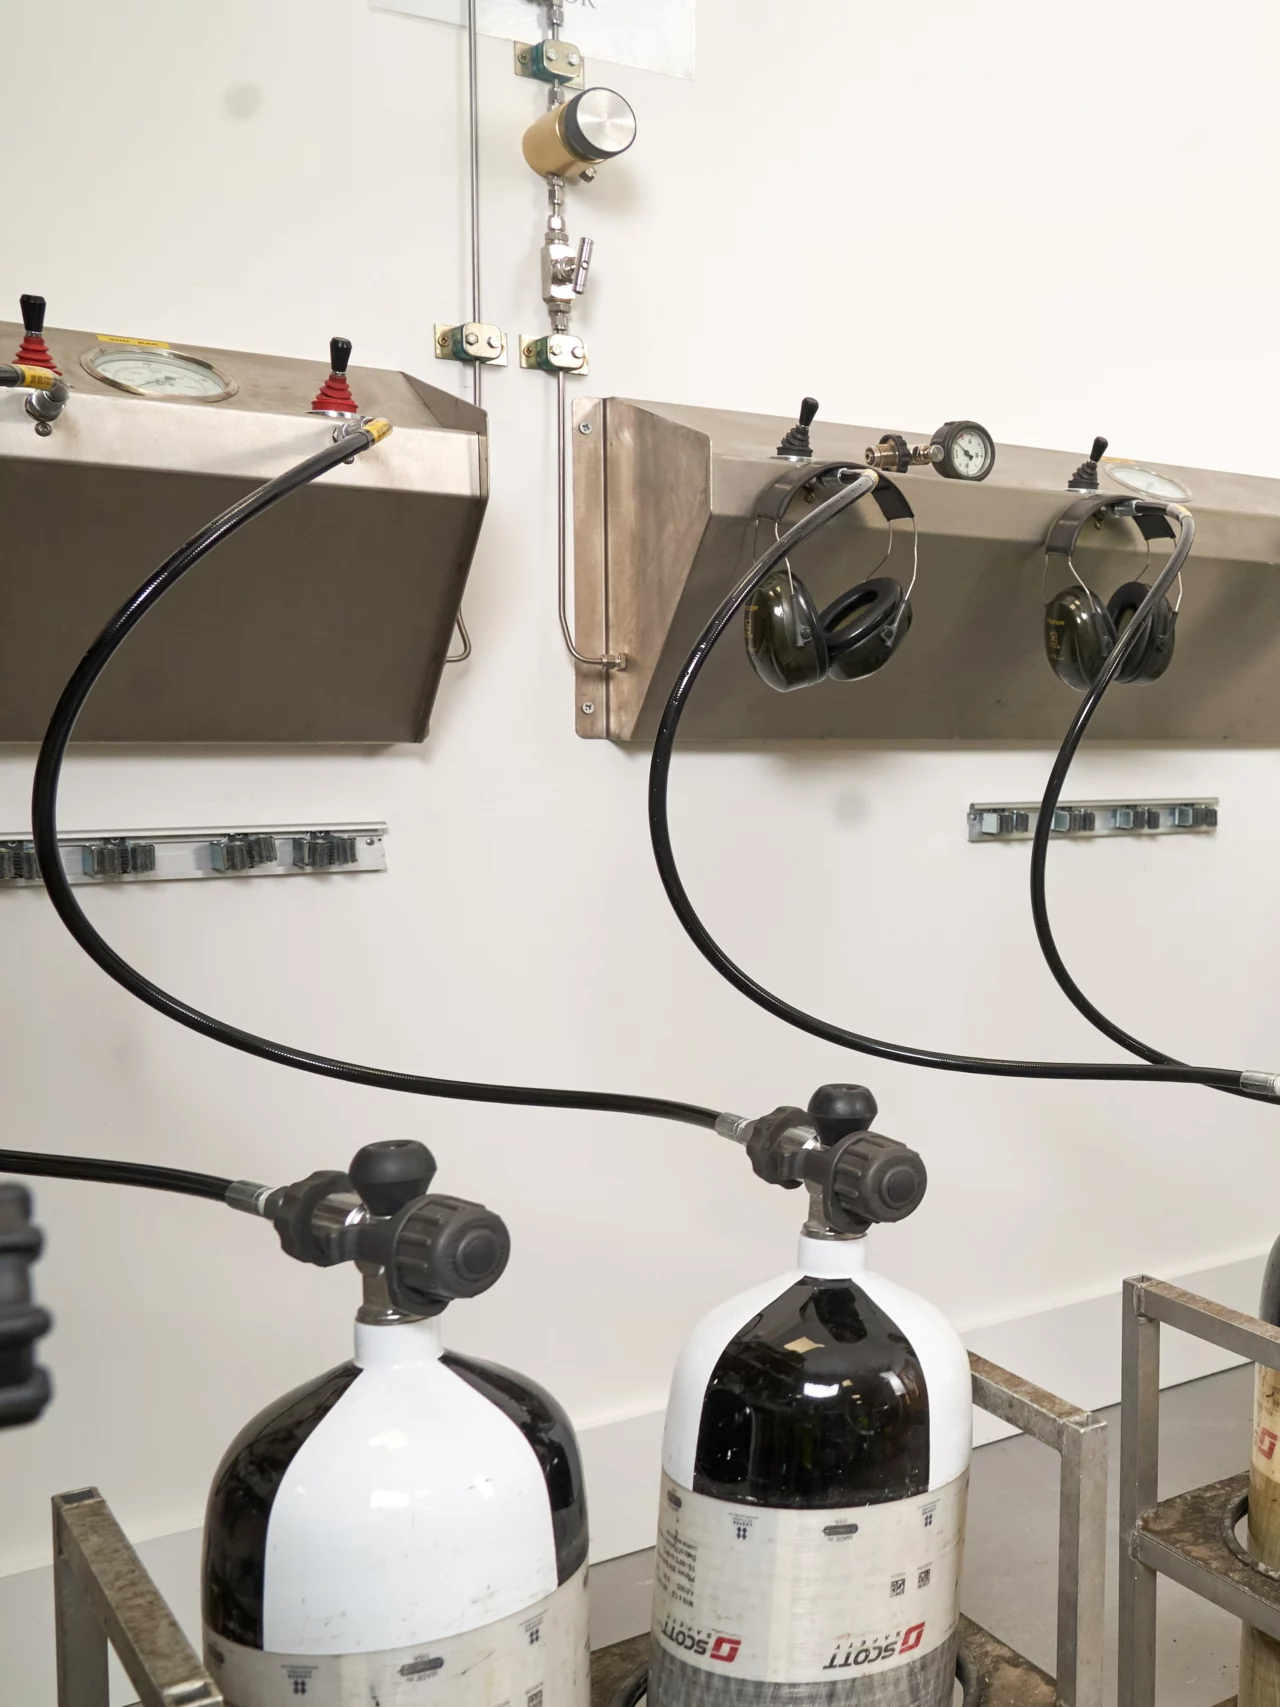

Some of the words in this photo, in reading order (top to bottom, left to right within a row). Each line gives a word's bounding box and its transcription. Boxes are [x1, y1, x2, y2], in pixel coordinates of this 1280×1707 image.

[661, 1620, 709, 1656] SCOTT
[835, 1631, 901, 1650] SAFETY
[822, 1641, 898, 1669] SCOTT
